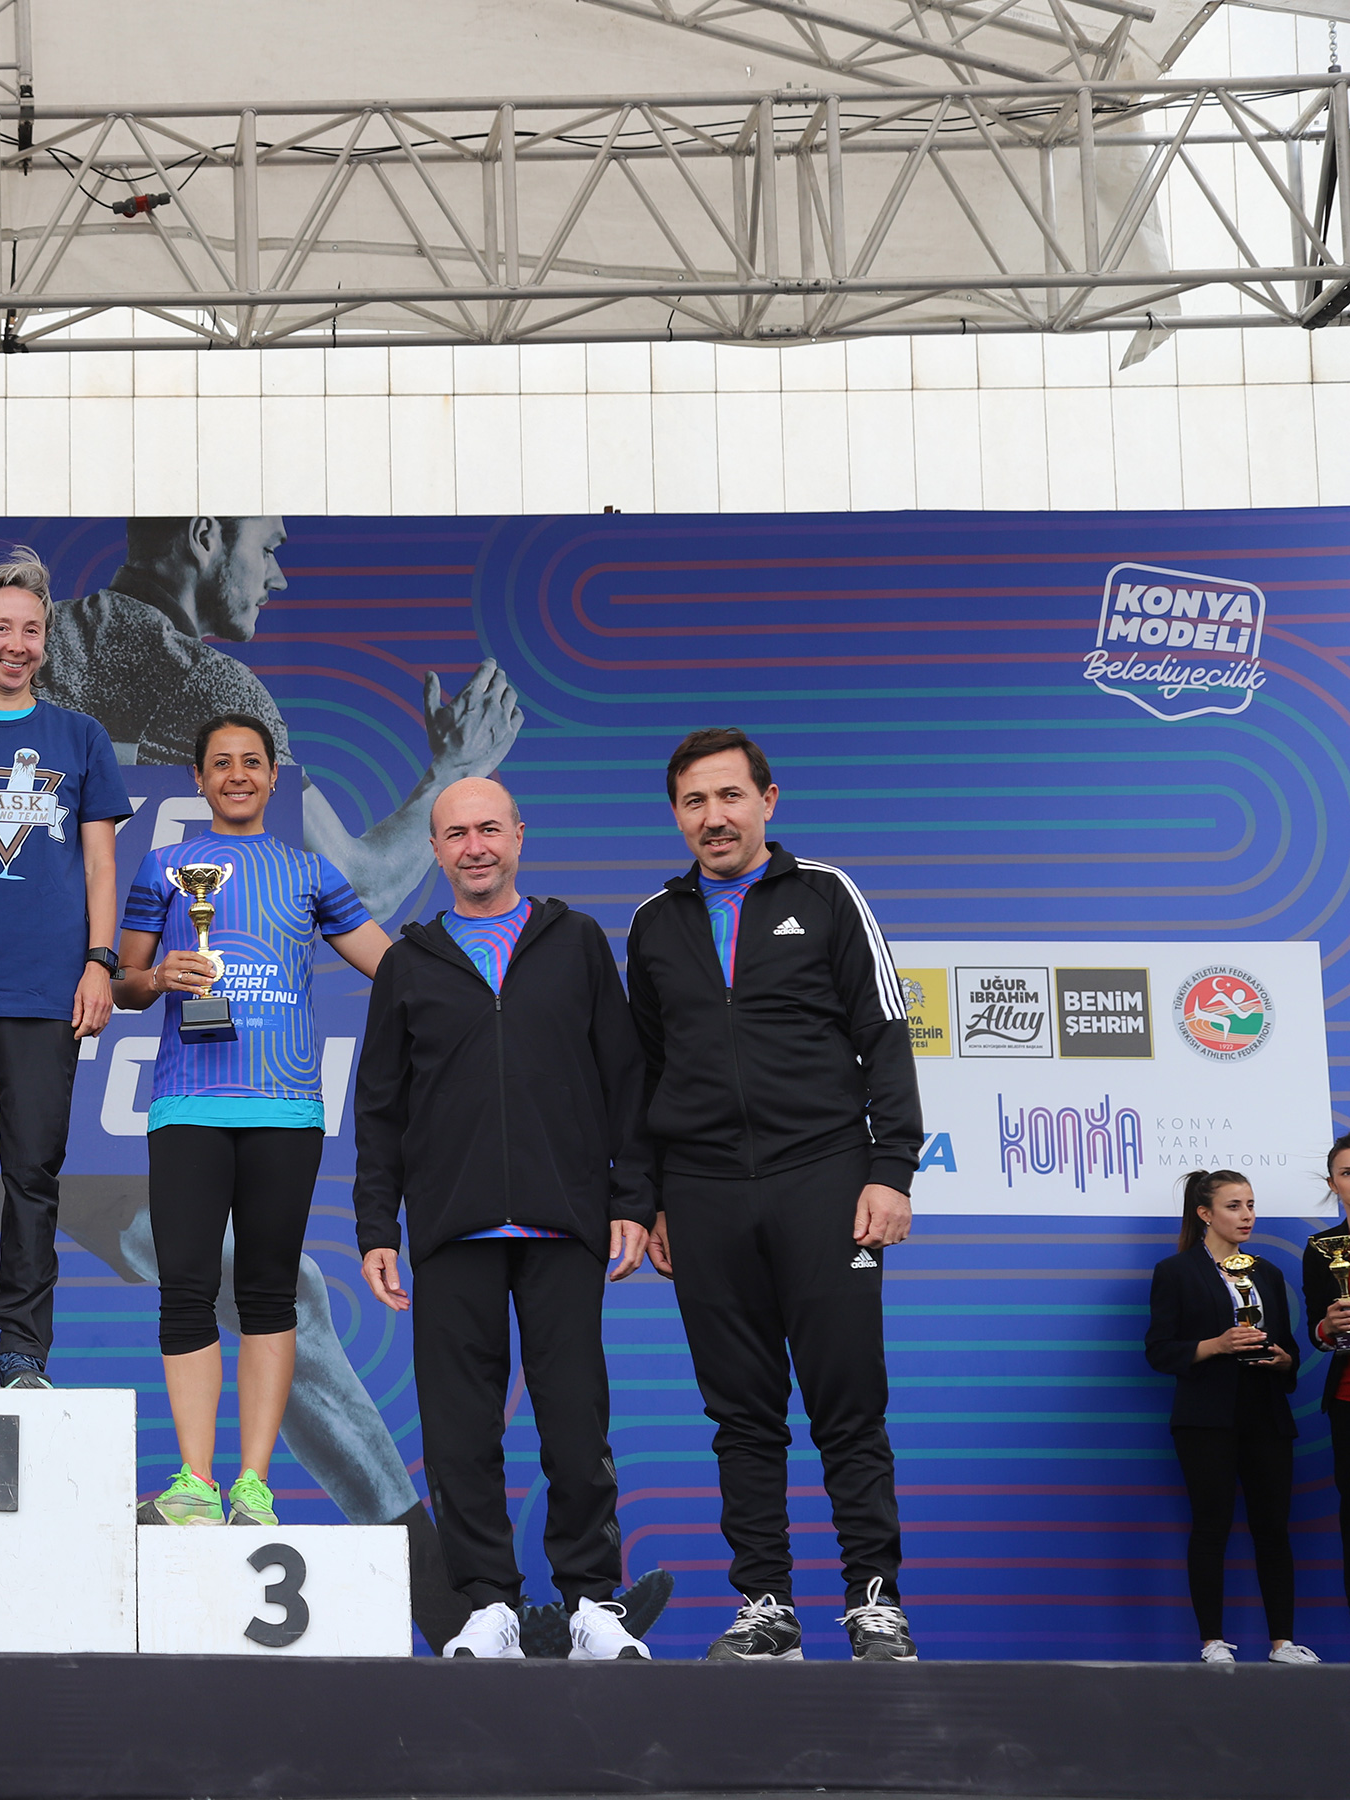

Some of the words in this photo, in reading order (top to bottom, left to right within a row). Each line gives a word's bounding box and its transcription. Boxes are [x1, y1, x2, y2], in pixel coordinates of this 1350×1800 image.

[1114, 583, 1253, 624] KONYA
[1083, 649, 1267, 700] Belediyecilik
[18, 811, 49, 822] TEAM
[225, 964, 279, 977] ONYA
[222, 977, 268, 989] YARI
[980, 975, 1026, 991] UĞUR
[1229, 968, 1273, 1011] FEDERASYONU
[965, 1004, 1045, 1043] Altay
[1200, 1047, 1237, 1061] ATHLETIC
[1238, 1021, 1272, 1059] FEDERATION
[1155, 1117, 1234, 1130] KONYA
[1157, 1136, 1209, 1149] YARI
[1158, 1154, 1289, 1167] MARATONU
[244, 1543, 311, 1648] 3
